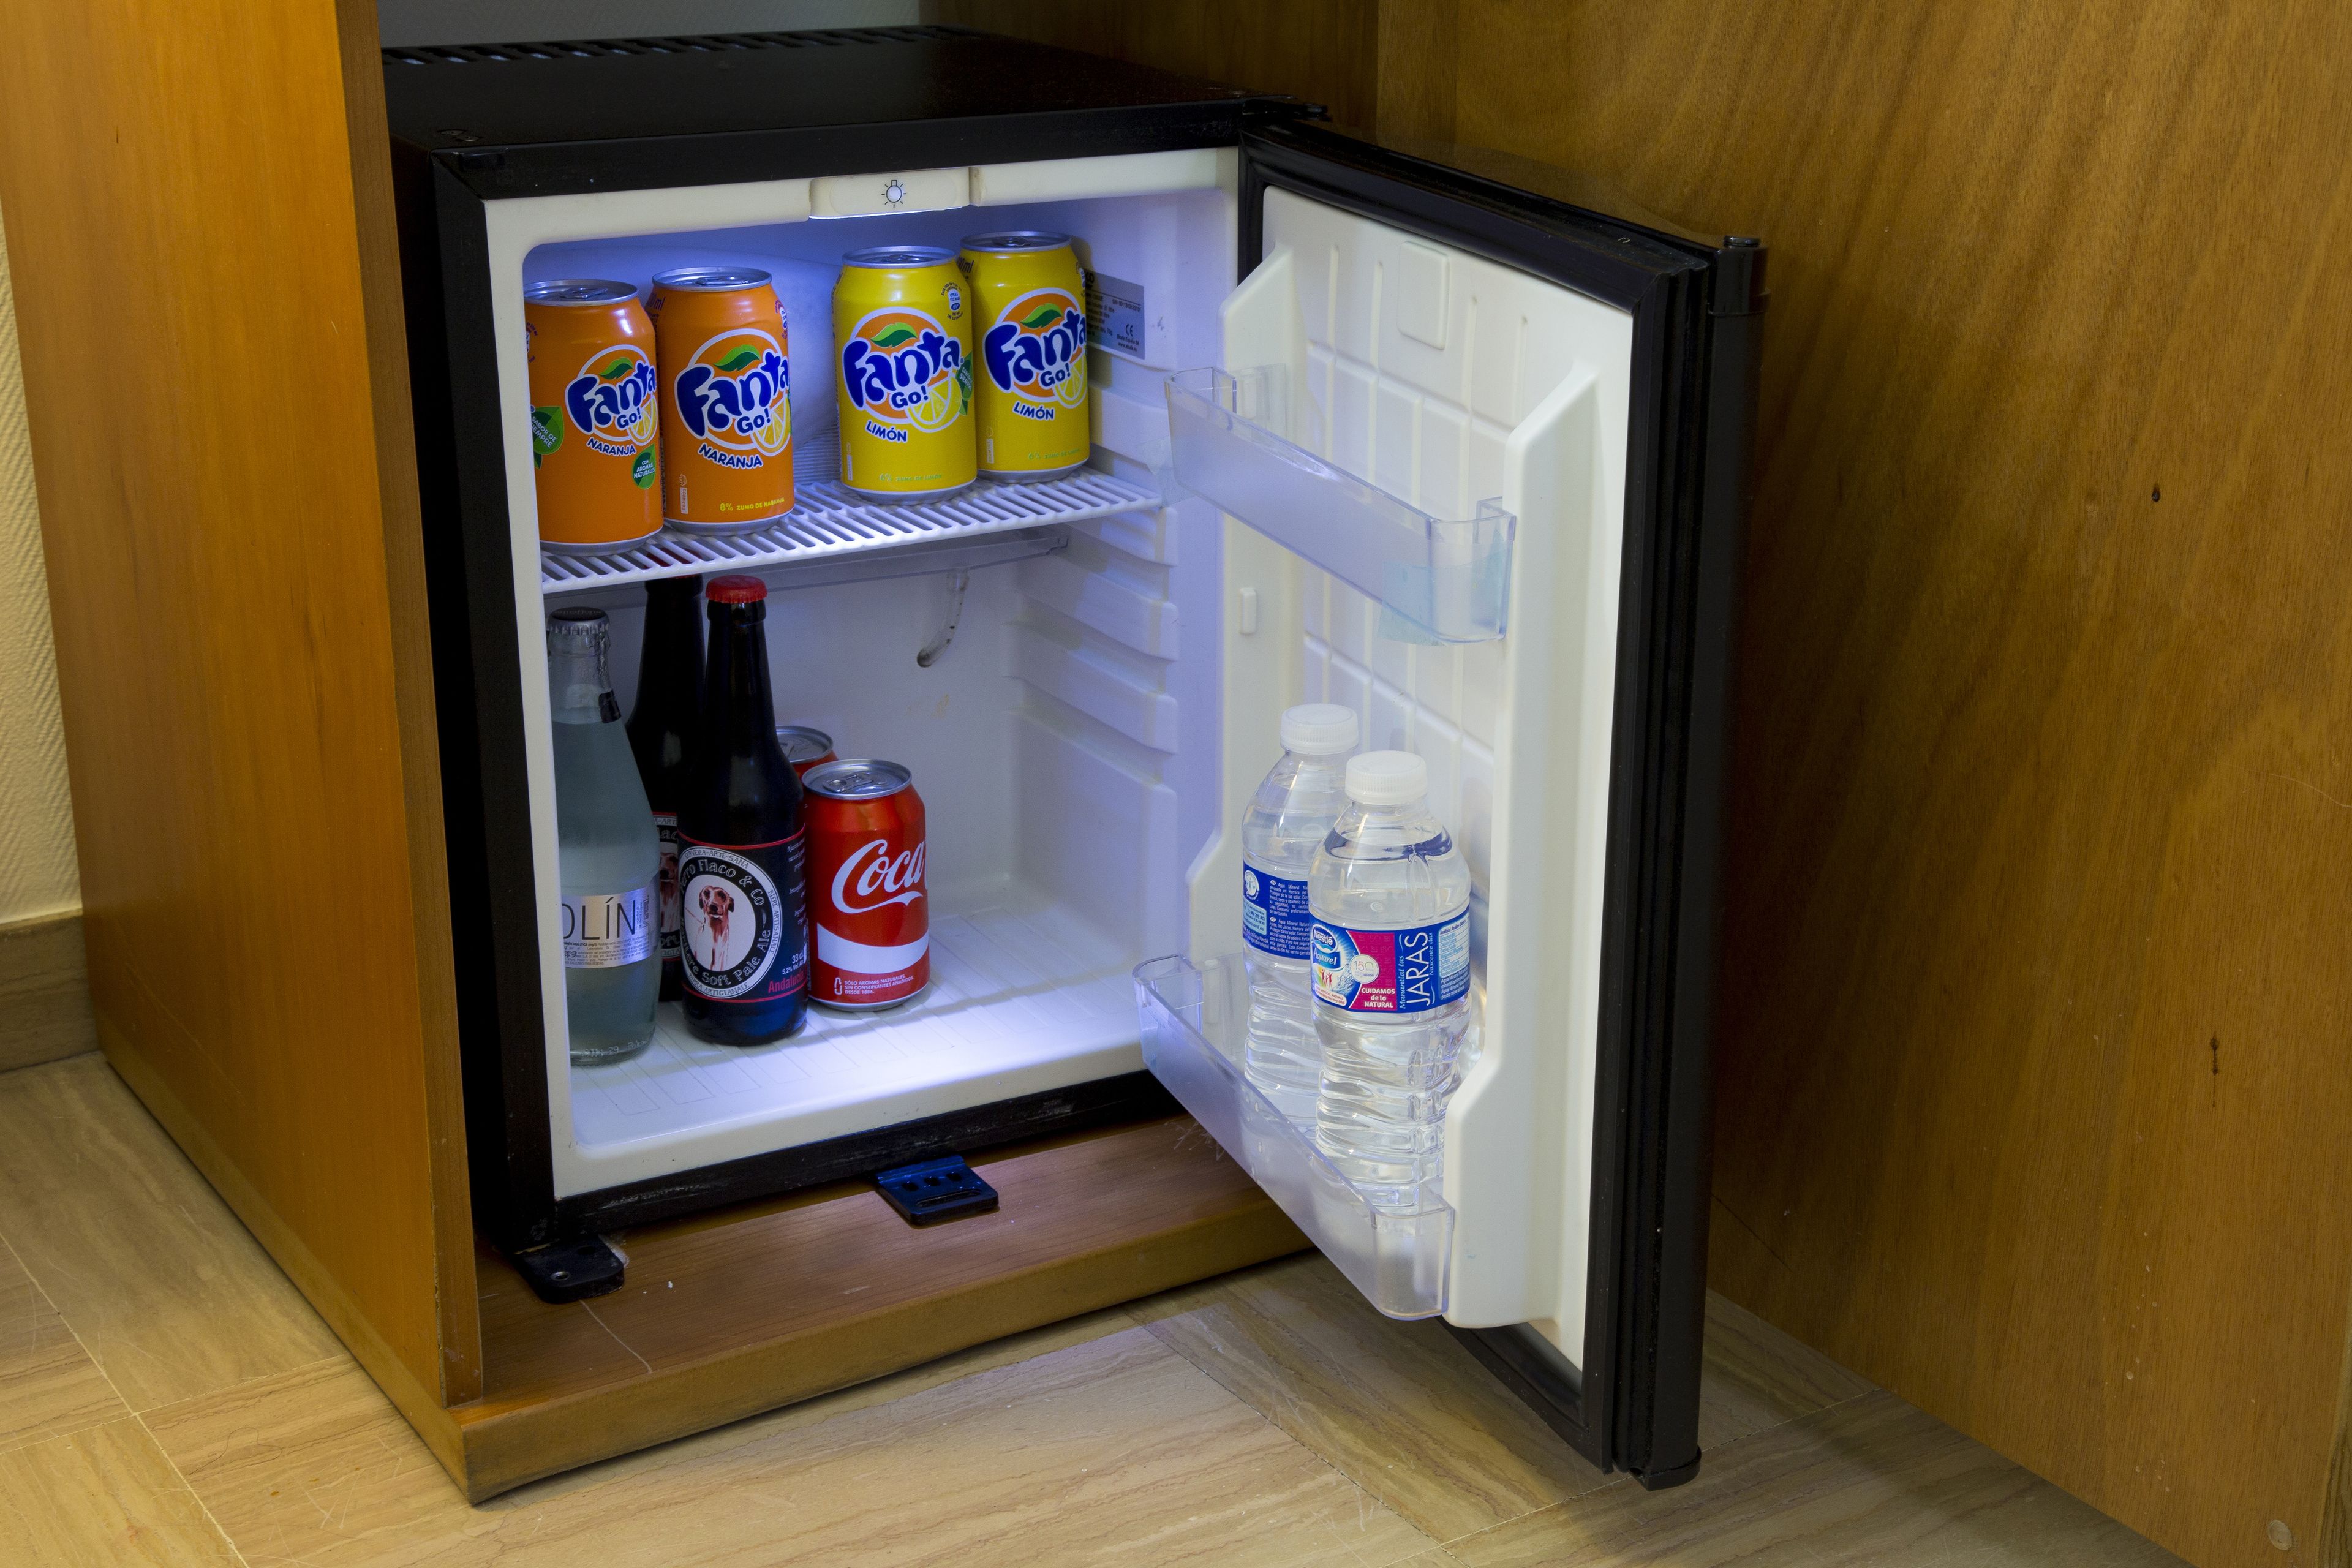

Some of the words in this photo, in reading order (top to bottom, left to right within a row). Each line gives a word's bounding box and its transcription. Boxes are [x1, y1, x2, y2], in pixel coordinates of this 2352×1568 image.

[984, 309, 1087, 391] Fanta
[843, 331, 960, 409] Fanta
[567, 361, 656, 433] Fanta
[676, 352, 789, 437] Fanta
[1012, 401, 1055, 420] LIMÓN
[531, 425, 552, 448] IEMPRE
[548, 432, 557, 443] DE
[865, 420, 908, 443] LIMÓN
[587, 437, 636, 456] NARANJA
[698, 443, 763, 469] NARANJA
[636, 463, 654, 473] AROMAS
[720, 503, 733, 511] 8%
[698, 859, 736, 878] Flaco
[739, 875, 752, 888] &
[769, 909, 780, 956] ARTISANALE
[1314, 929, 1333, 946] Nestlé
[701, 971, 731, 986] Soft
[733, 956, 761, 981] Pale
[756, 930, 771, 954] Ale
[792, 953, 799, 964] 33
[1313, 947, 1336, 966] Aquarel
[1404, 932, 1431, 1006] JARAS
[853, 981, 891, 990] CONSERVANTES
